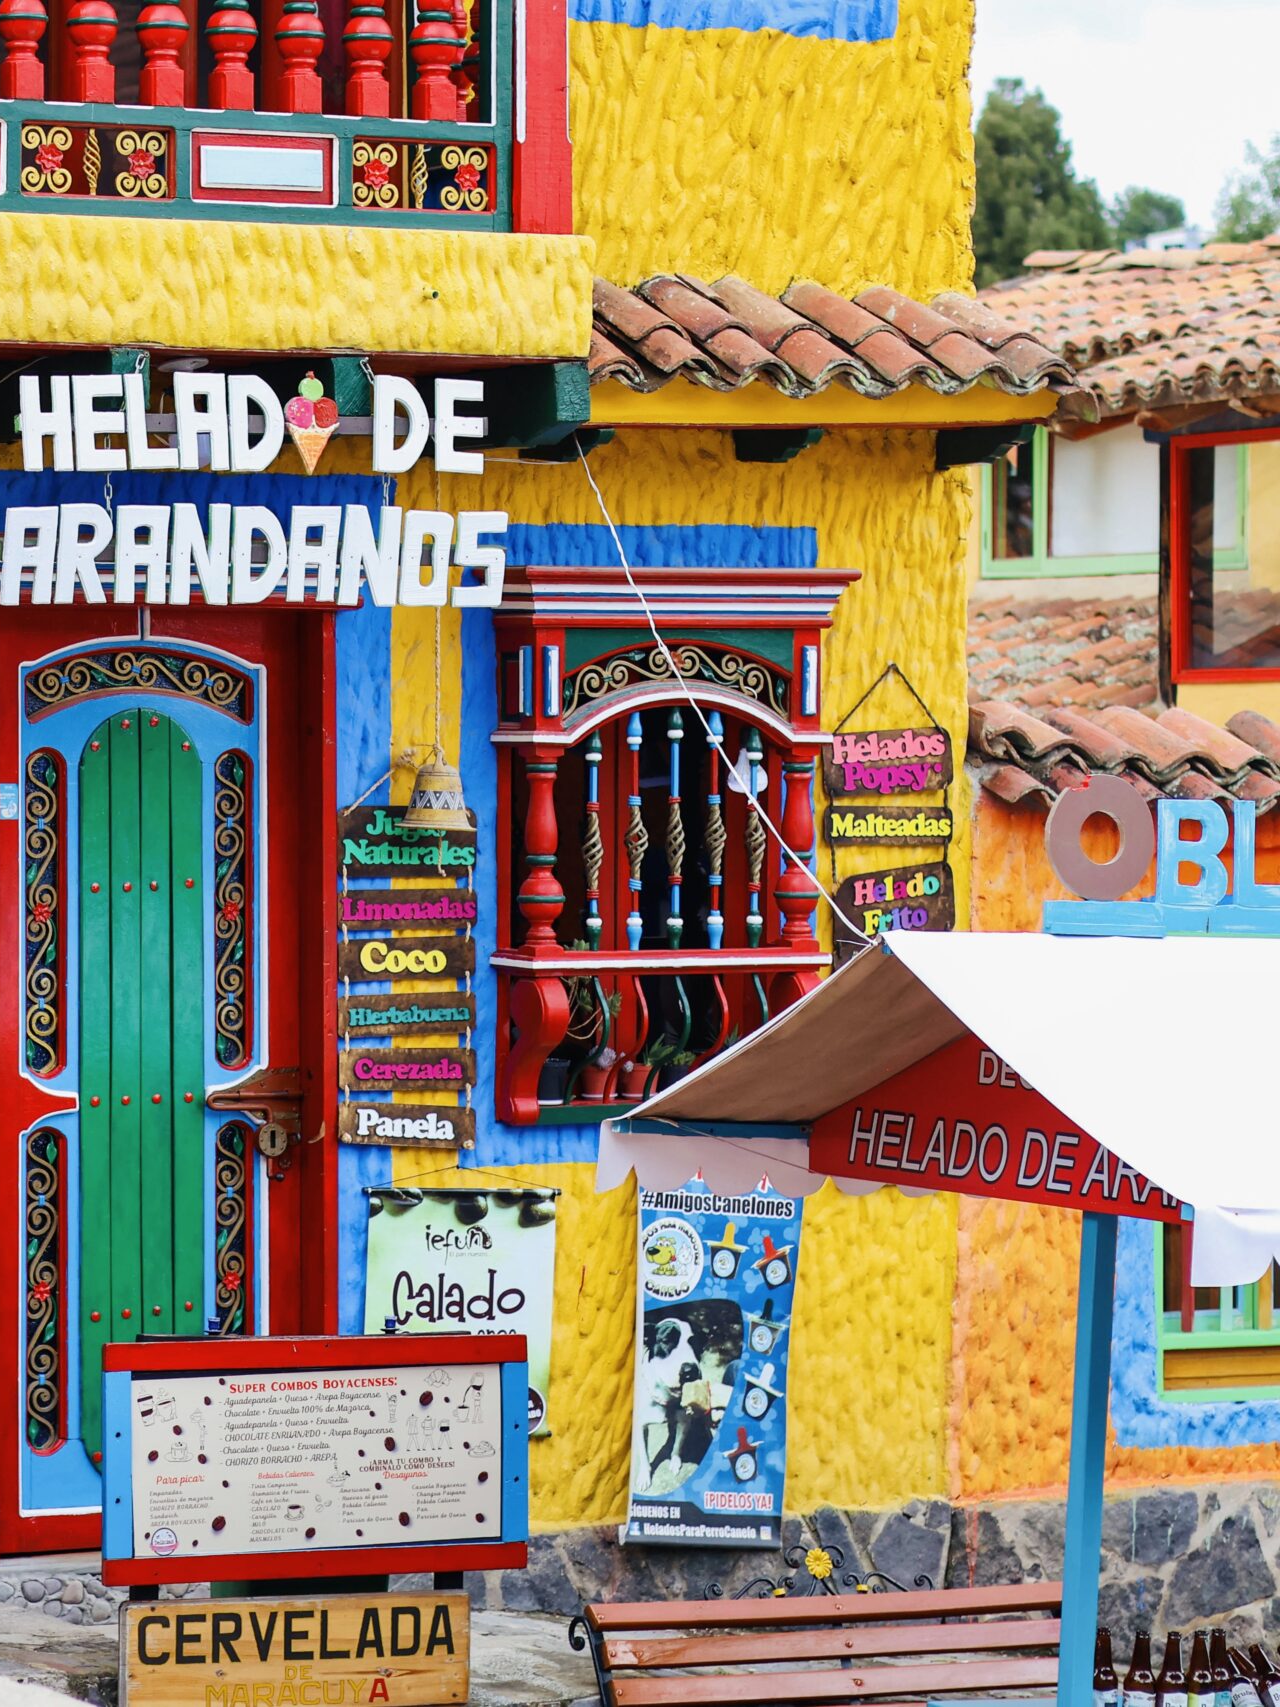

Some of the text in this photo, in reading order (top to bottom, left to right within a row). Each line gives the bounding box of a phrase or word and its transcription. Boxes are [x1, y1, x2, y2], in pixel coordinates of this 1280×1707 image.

[372, 374, 484, 474] DE
[833, 730, 945, 766] Helados
[842, 762, 930, 795] Popsy
[830, 813, 951, 838] Malteadas
[342, 839, 476, 866] Naturales
[1045, 773, 1280, 907] OBL
[853, 871, 940, 906] Helado
[341, 896, 477, 921] Limonadas
[863, 905, 928, 936] Frito
[360, 941, 447, 973] Coco
[348, 1004, 470, 1027] Hierbabuena
[354, 1058, 463, 1080] Cerezada
[356, 1108, 455, 1141] Panela
[847, 1108, 1009, 1182] HELADO
[1016, 1130, 1080, 1193] DE
[641, 1190, 794, 1218] #AmigosCanelones
[392, 1268, 526, 1326] Calado
[229, 1377, 397, 1393] SUPER COMBOS BOYACENSES:
[284, 1394, 308, 1403] Queso
[301, 1404, 323, 1414] 100%
[285, 1419, 308, 1427] Queso
[225, 1432, 270, 1442] CHOCOLATE
[267, 1444, 290, 1452] Queso
[225, 1458, 258, 1466] CHORIZO
[156, 1476, 178, 1485] Para
[670, 1506, 680, 1519] EN
[704, 1492, 773, 1510] ¡PIDELOS YA!
[137, 1604, 455, 1666] CERVELADA
[284, 1665, 313, 1681] DE
[204, 1678, 390, 1706] MARACUYA
